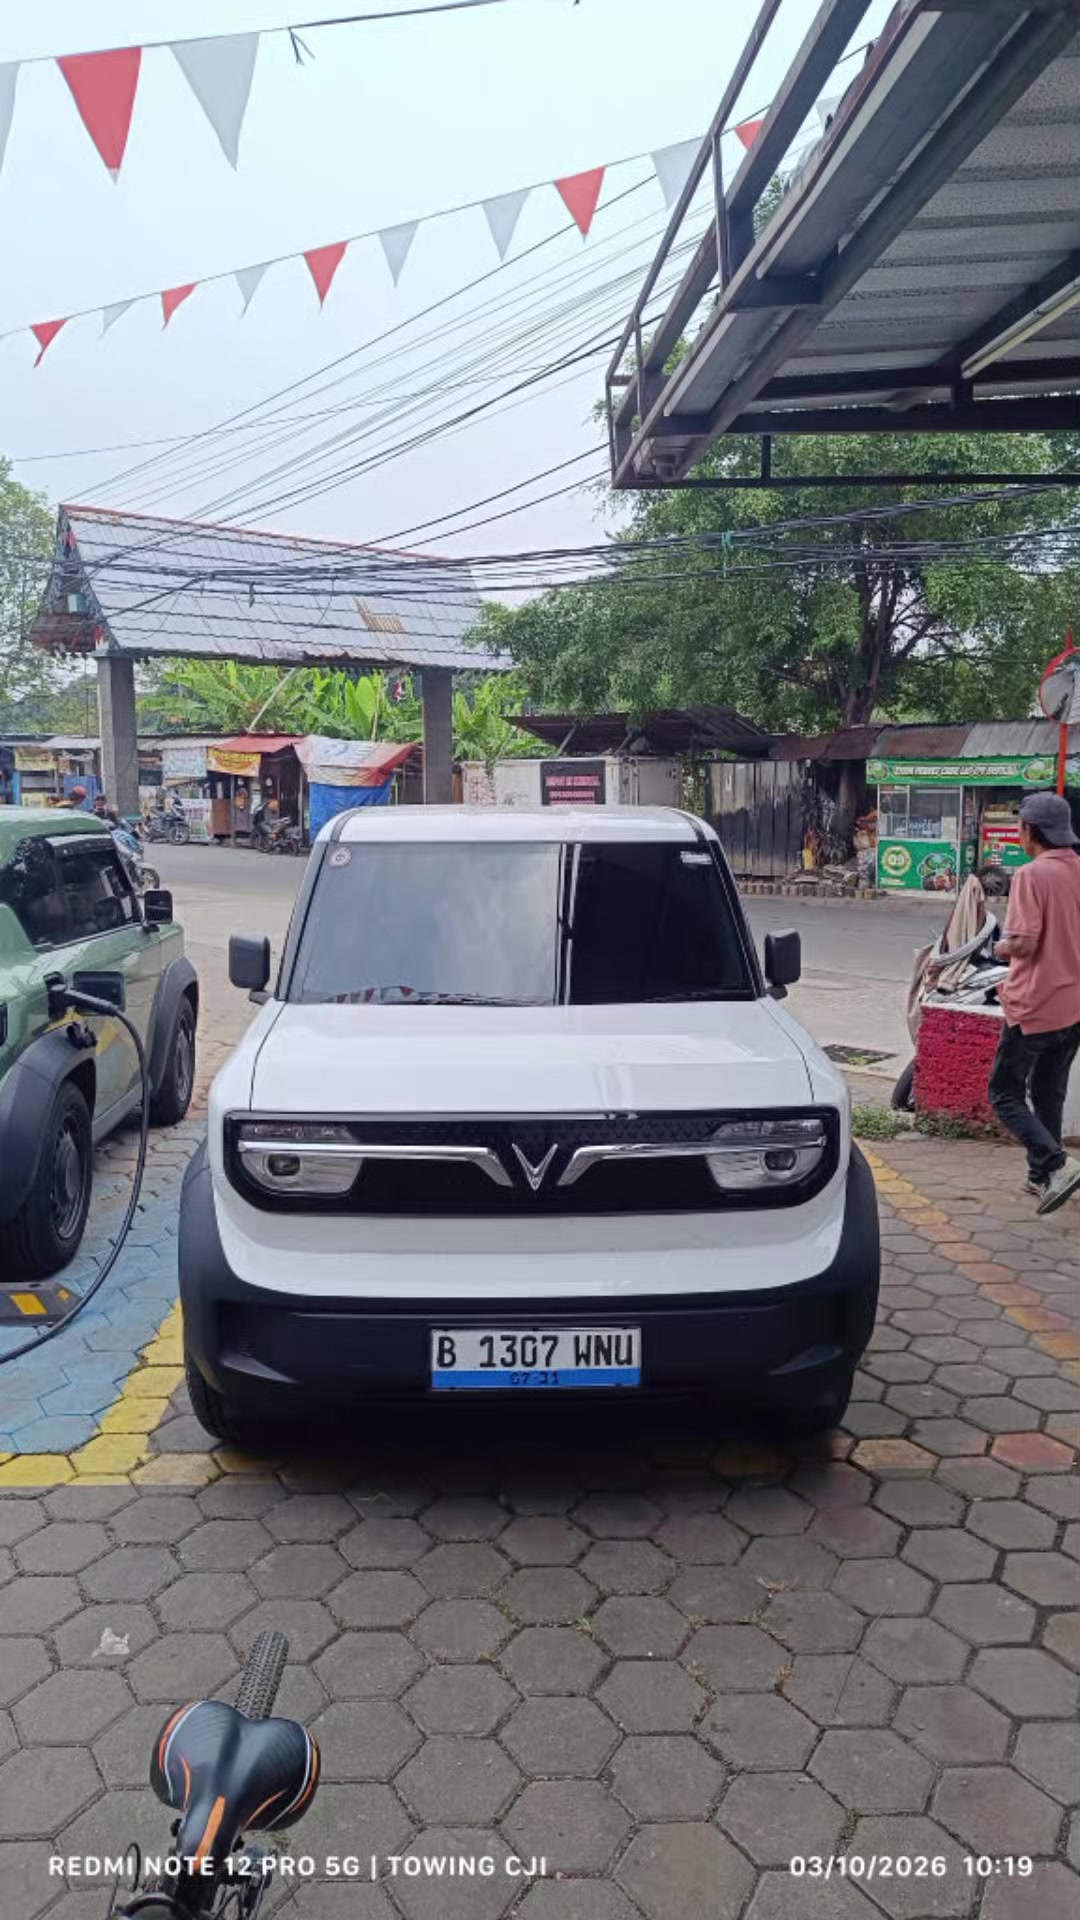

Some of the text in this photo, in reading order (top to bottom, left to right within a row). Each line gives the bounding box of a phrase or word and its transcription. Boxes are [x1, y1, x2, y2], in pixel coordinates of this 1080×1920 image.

[437, 1334, 633, 1368] B 1307 WNU
